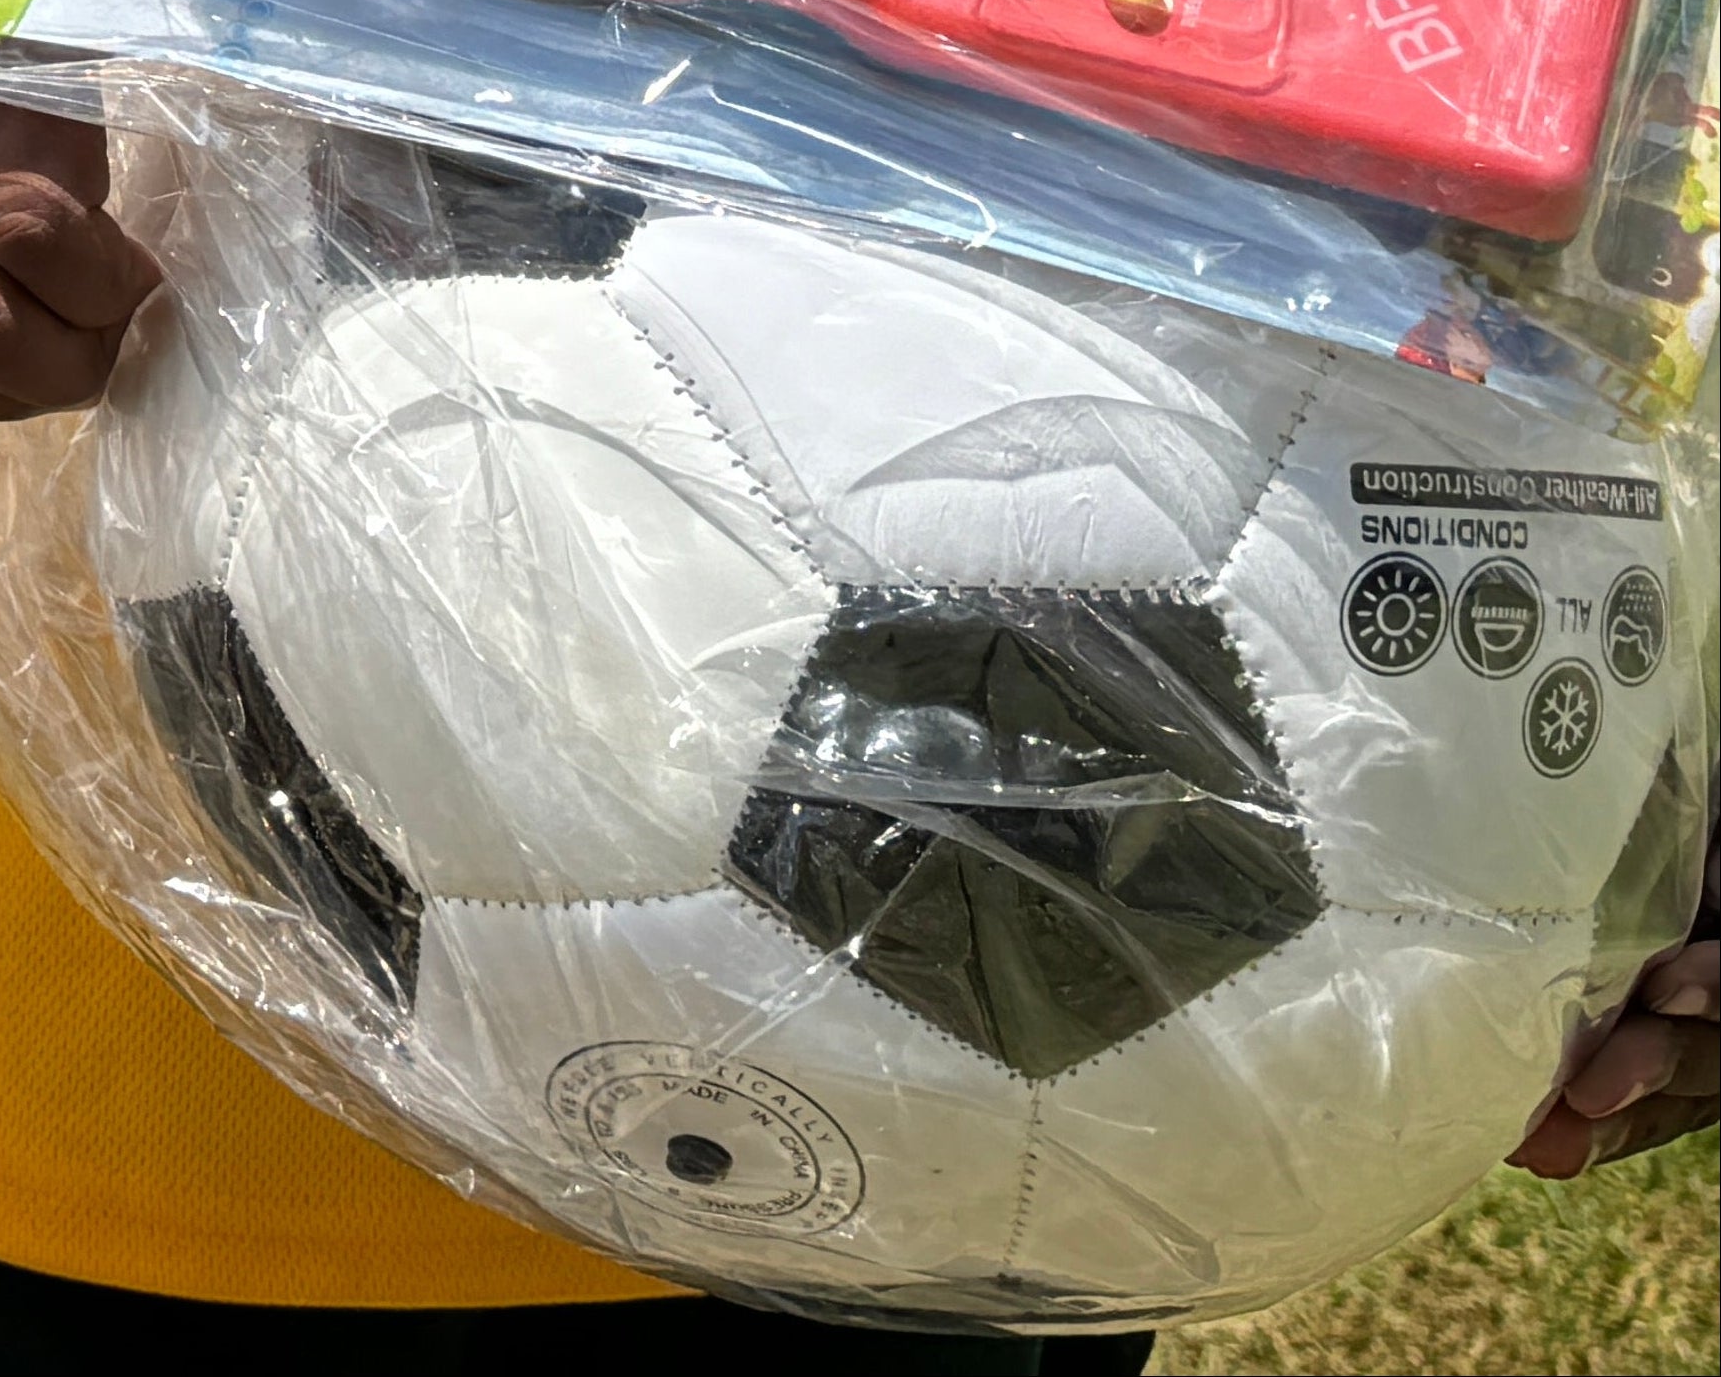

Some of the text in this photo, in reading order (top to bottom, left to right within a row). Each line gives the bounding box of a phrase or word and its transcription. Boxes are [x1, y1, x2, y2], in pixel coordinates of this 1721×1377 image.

[1363, 467, 1657, 515] All-Weather Construction
[1361, 515, 1529, 549] CONDITIONS
[1556, 596, 1592, 635] ALL
